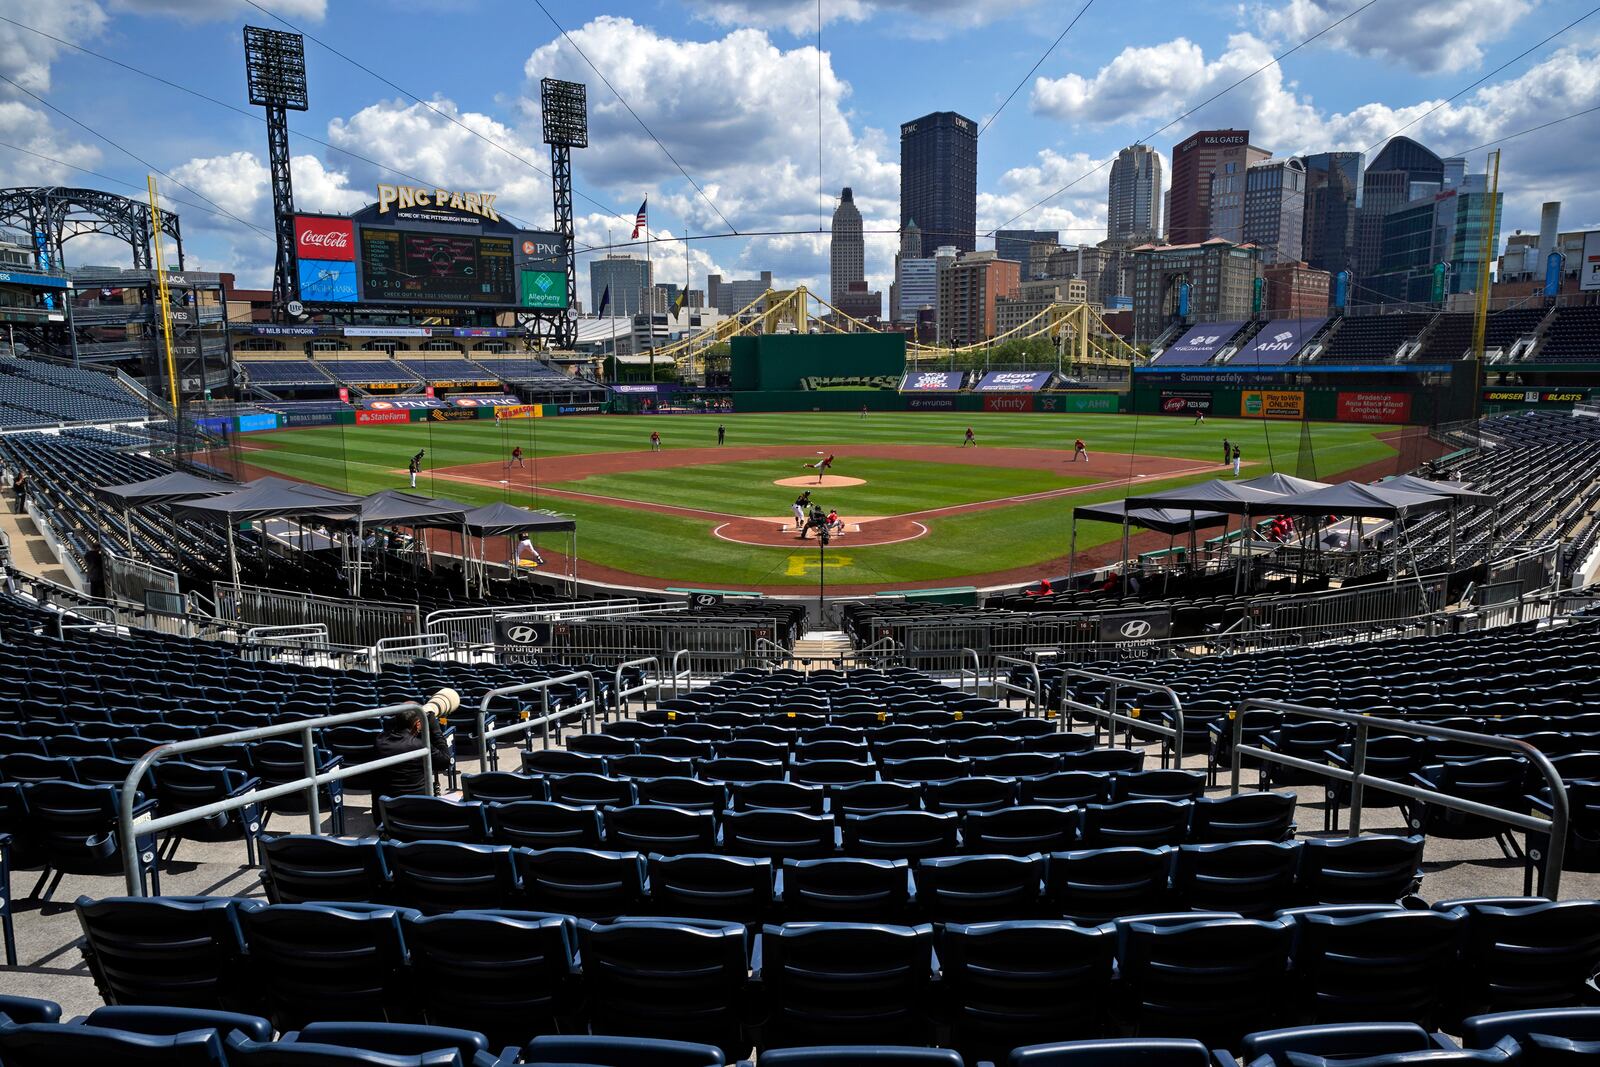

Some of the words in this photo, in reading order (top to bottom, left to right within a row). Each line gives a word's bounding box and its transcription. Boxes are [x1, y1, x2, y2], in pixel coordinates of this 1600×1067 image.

[1204, 136, 1219, 144] K&L
[1219, 136, 1245, 144] GATES
[378, 184, 431, 214] PNC
[435, 189, 500, 223] PARK
[301, 229, 349, 248] Coca-Cola
[536, 243, 562, 255] PNC
[529, 293, 560, 302] Allegheny
[1253, 341, 1294, 351] AHN
[1180, 373, 1215, 382] Summer
[1217, 373, 1244, 383] safely.
[1490, 392, 1525, 400] BOWSER
[395, 400, 441, 408] PNC
[478, 398, 517, 406] PNC
[991, 397, 1026, 410] xfinity
[1087, 400, 1110, 408] AHN
[1114, 639, 1156, 649] HYUNDAI
[1120, 650, 1149, 659] CLUB
